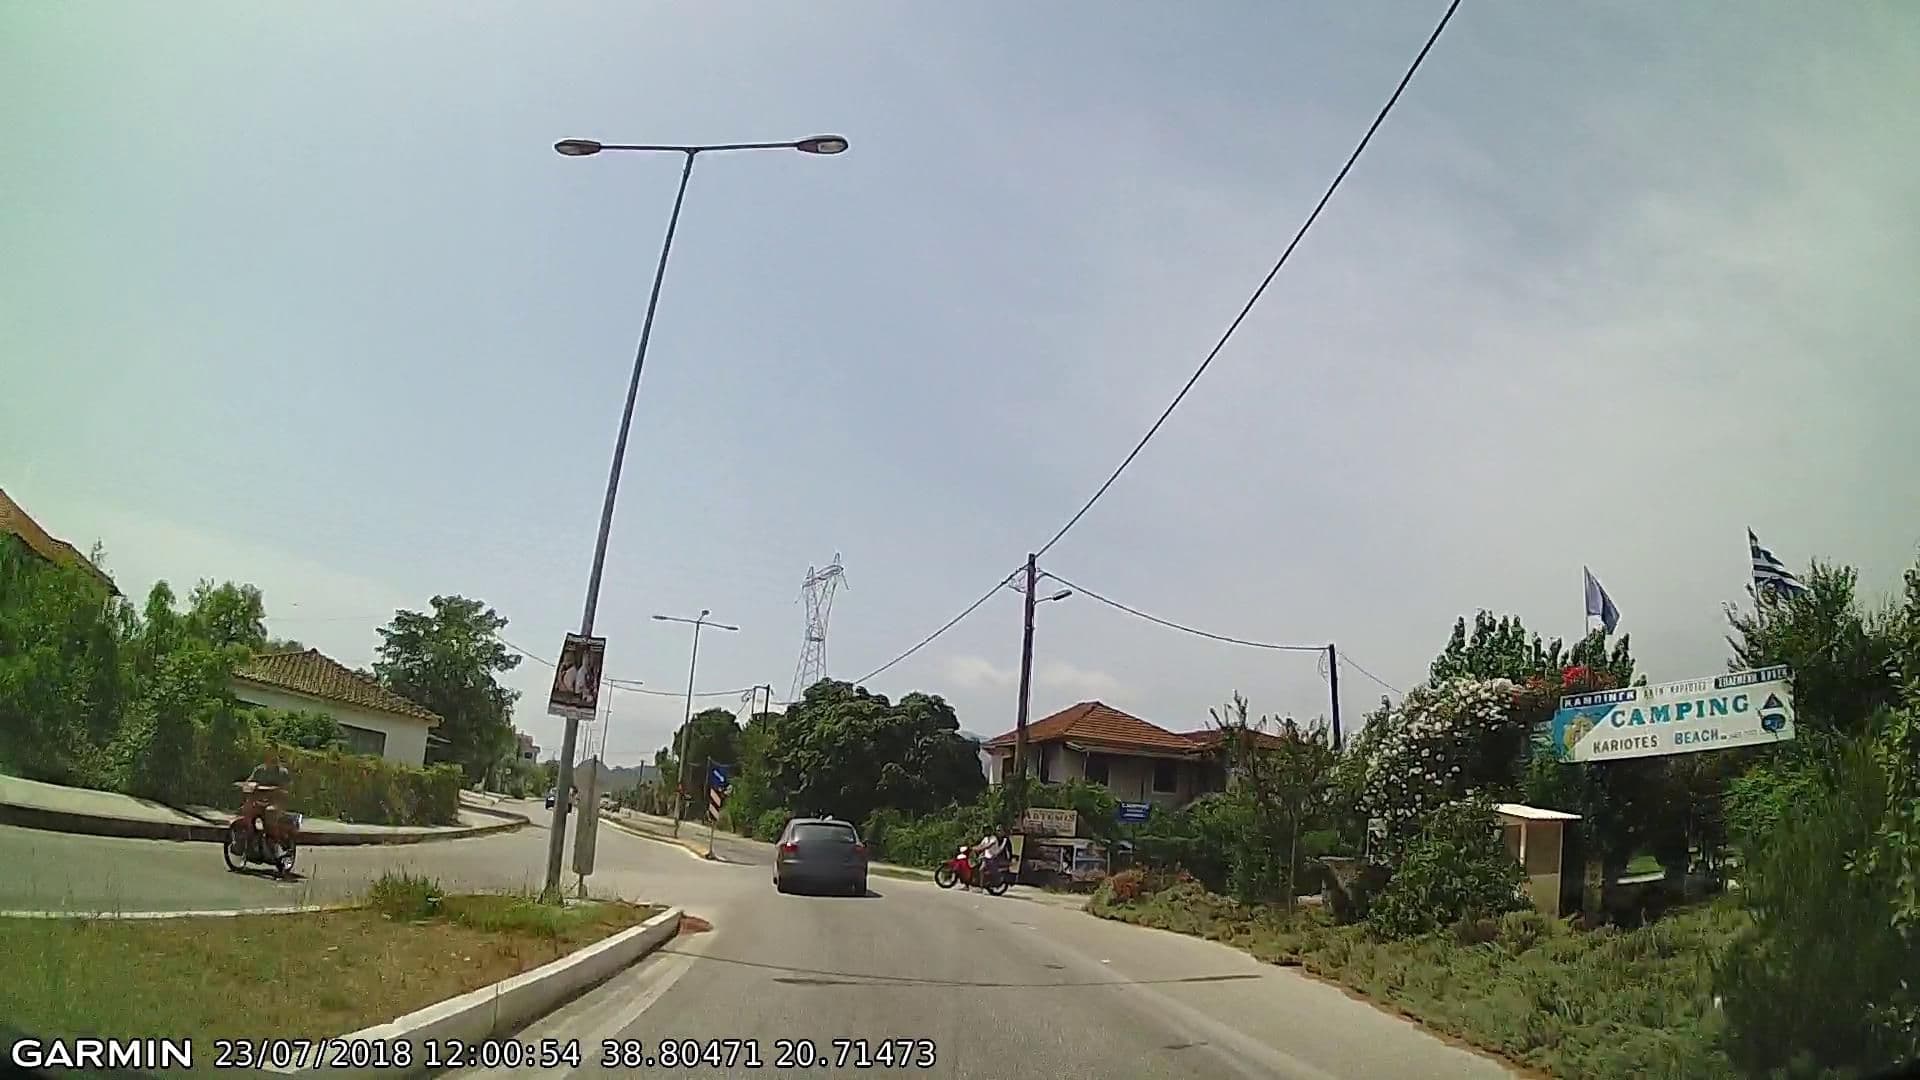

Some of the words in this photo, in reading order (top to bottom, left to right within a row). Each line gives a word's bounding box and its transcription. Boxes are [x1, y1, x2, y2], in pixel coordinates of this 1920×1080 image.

[1610, 694, 1749, 728] CAMPING
[1593, 735, 1658, 754] KARIOTES
[1674, 729, 1719, 746] BEACH
